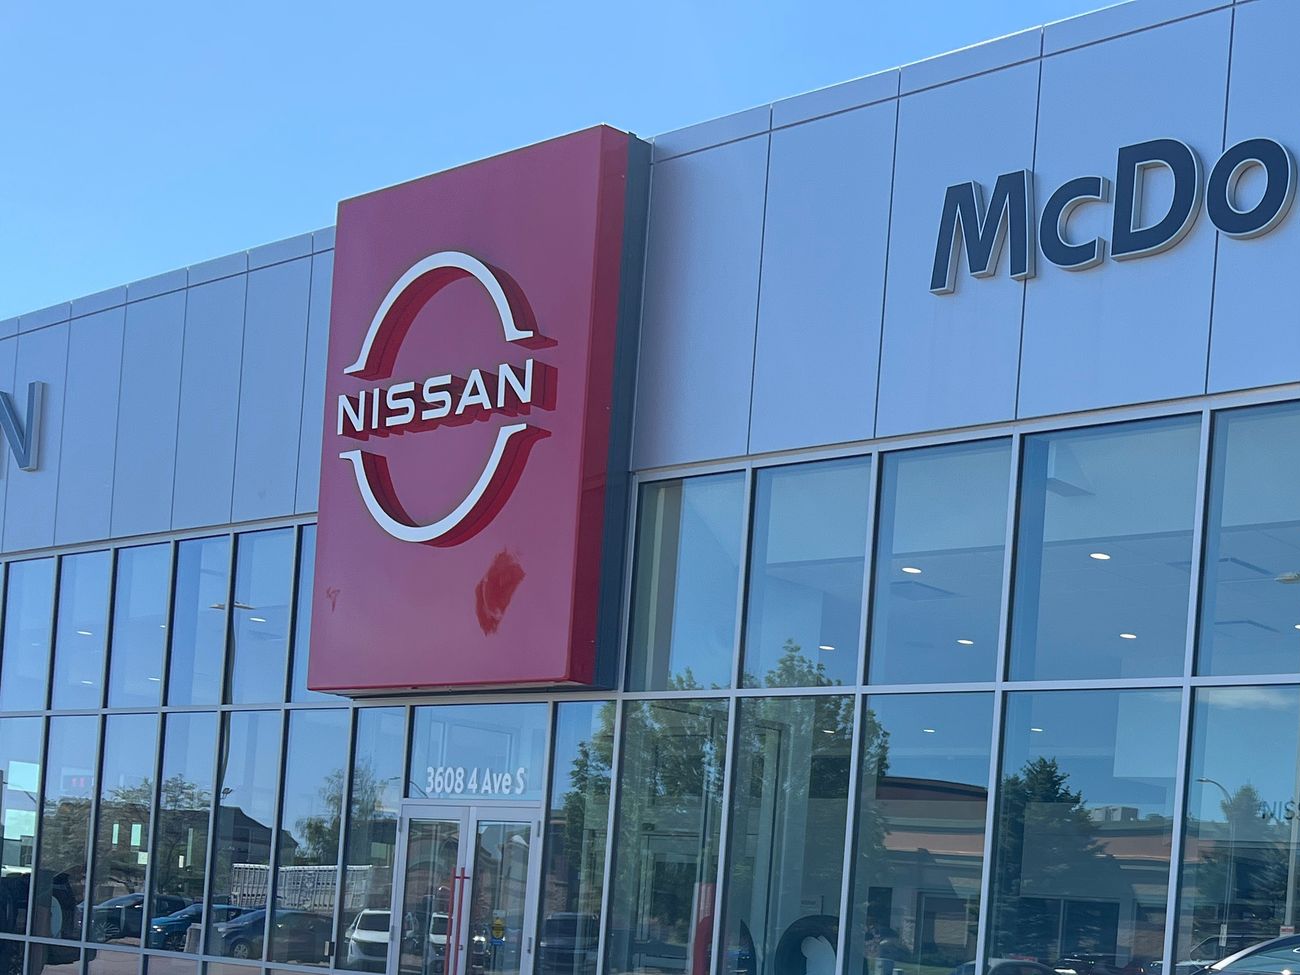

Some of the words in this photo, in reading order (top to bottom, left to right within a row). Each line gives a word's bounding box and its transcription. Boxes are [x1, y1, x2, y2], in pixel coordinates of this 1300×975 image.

[337, 358, 535, 436] NISSAN
[425, 766, 465, 794] 3608
[467, 767, 478, 794] 4
[481, 767, 512, 795] Ave
[515, 767, 525, 795] S
